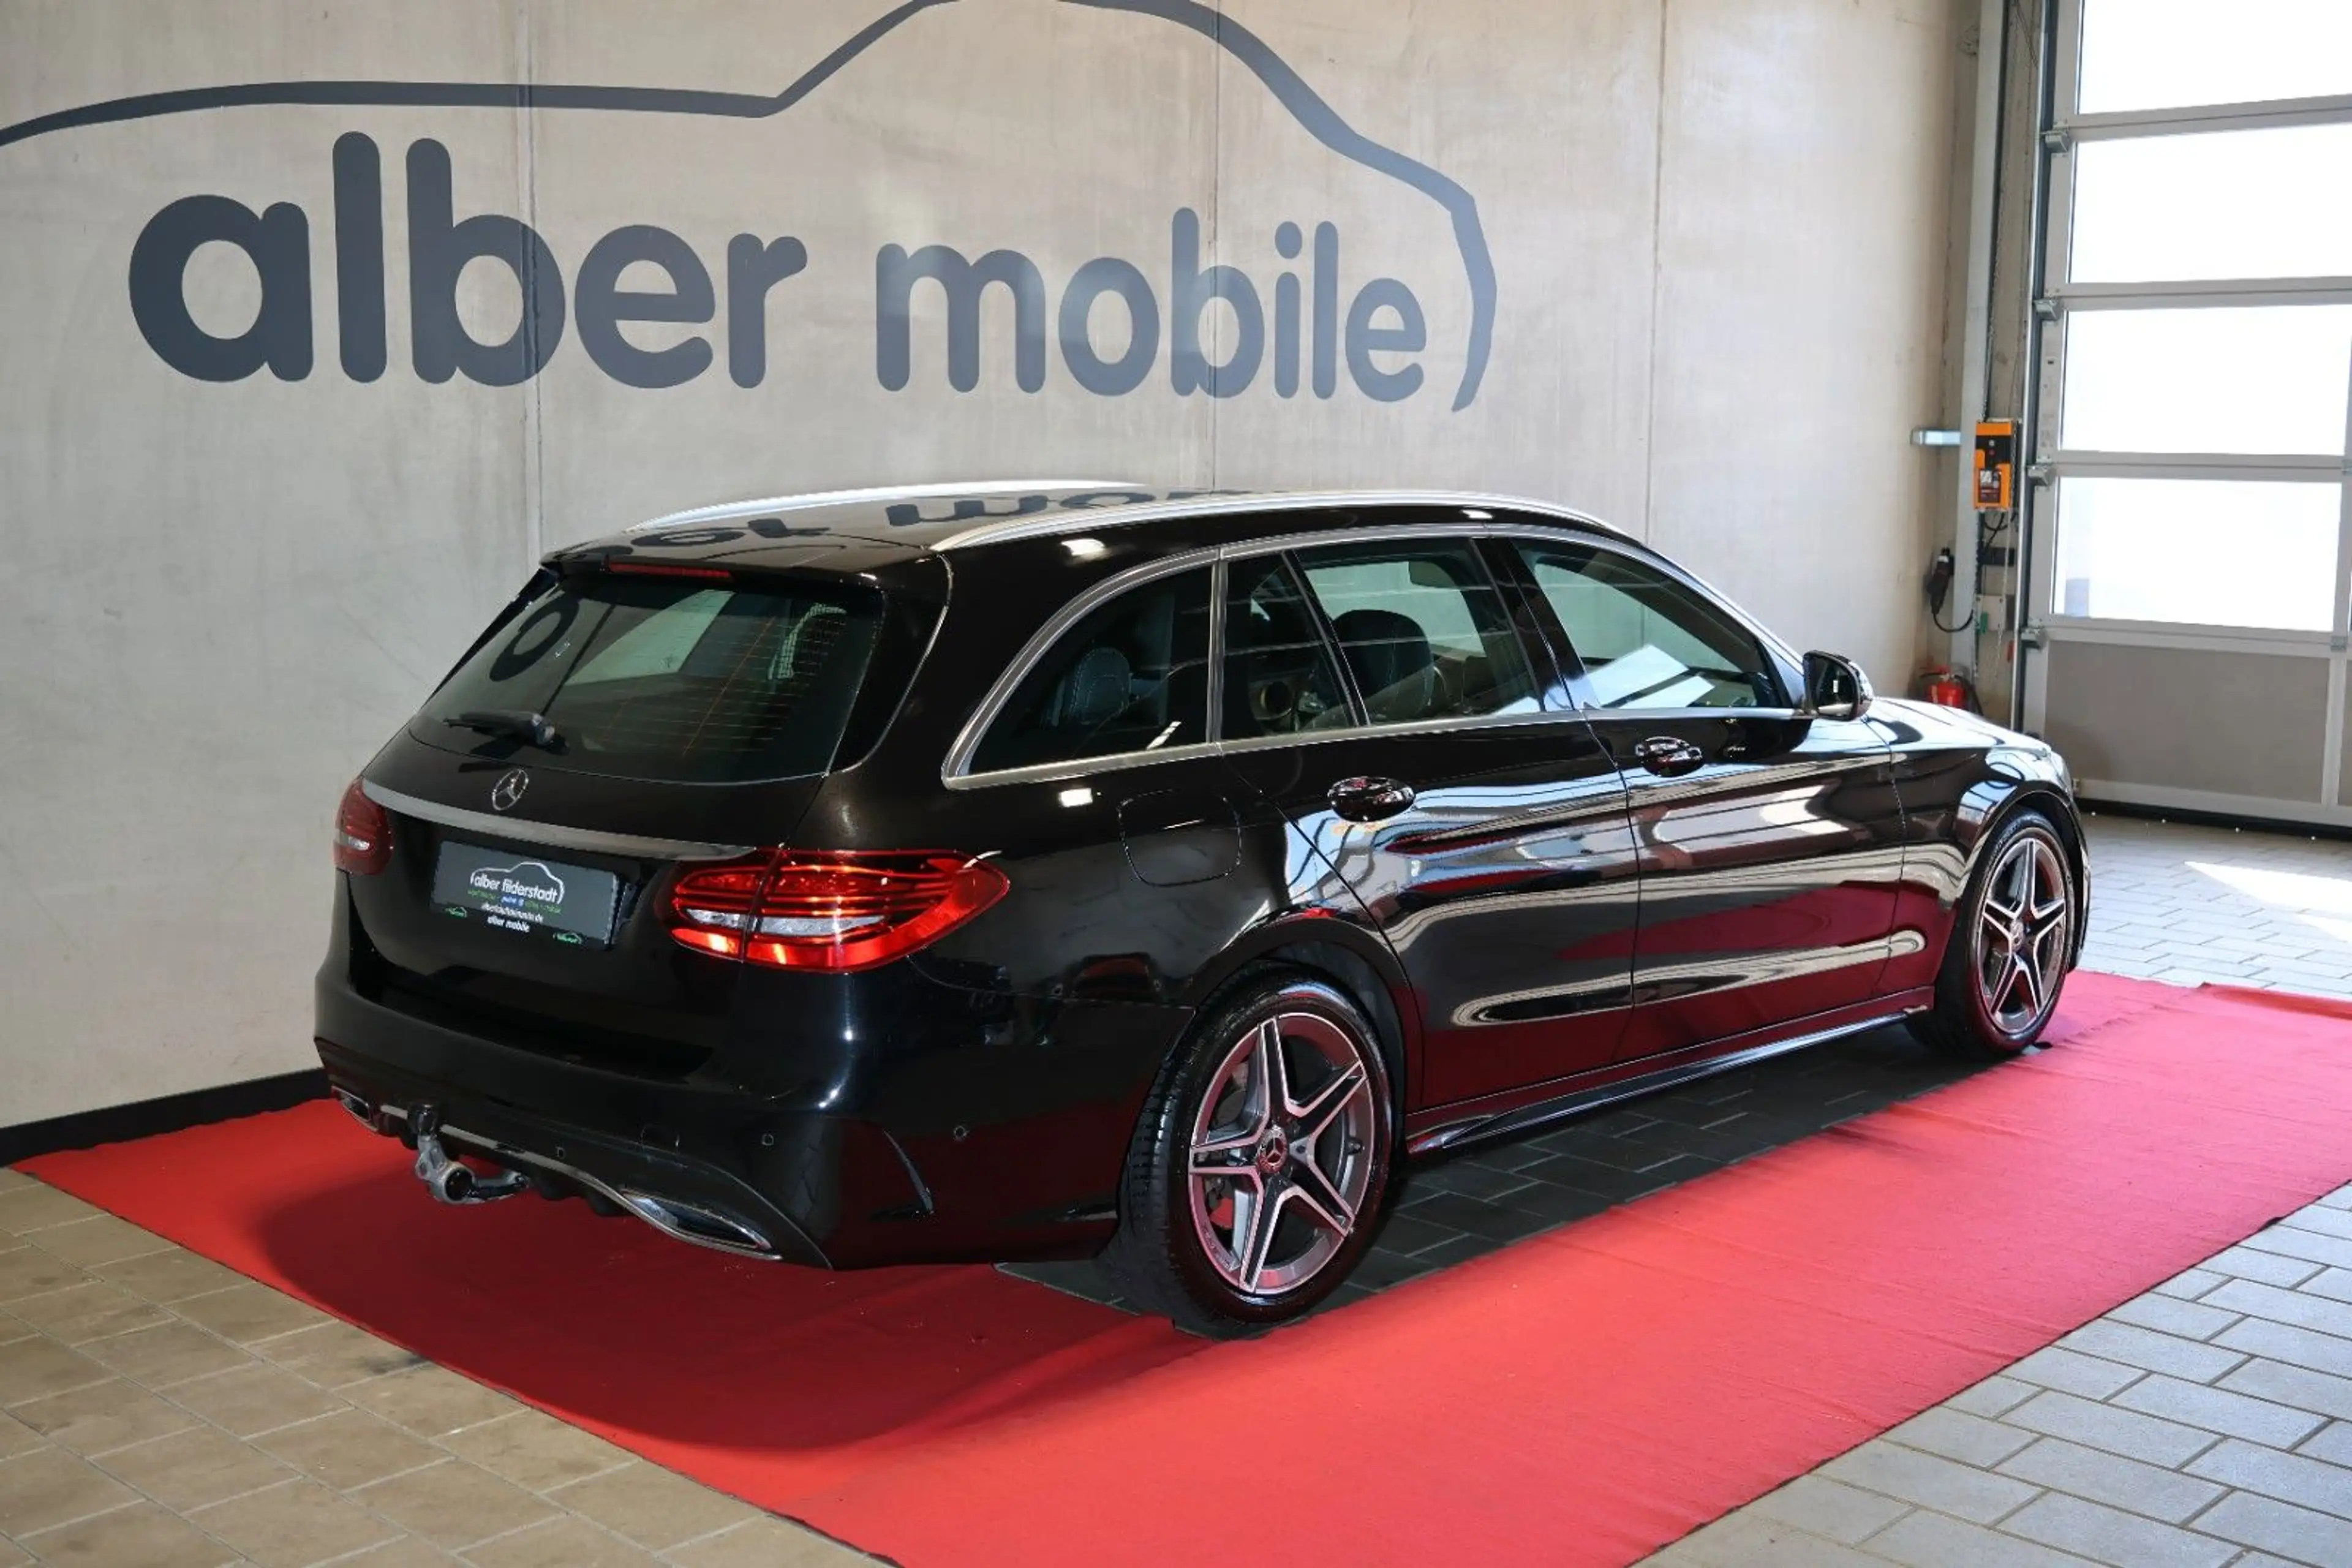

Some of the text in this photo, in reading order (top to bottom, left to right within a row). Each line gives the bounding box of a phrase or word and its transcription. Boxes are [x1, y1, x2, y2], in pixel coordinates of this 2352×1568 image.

[128, 131, 1427, 402] alber mobile
[474, 873, 500, 891] alber
